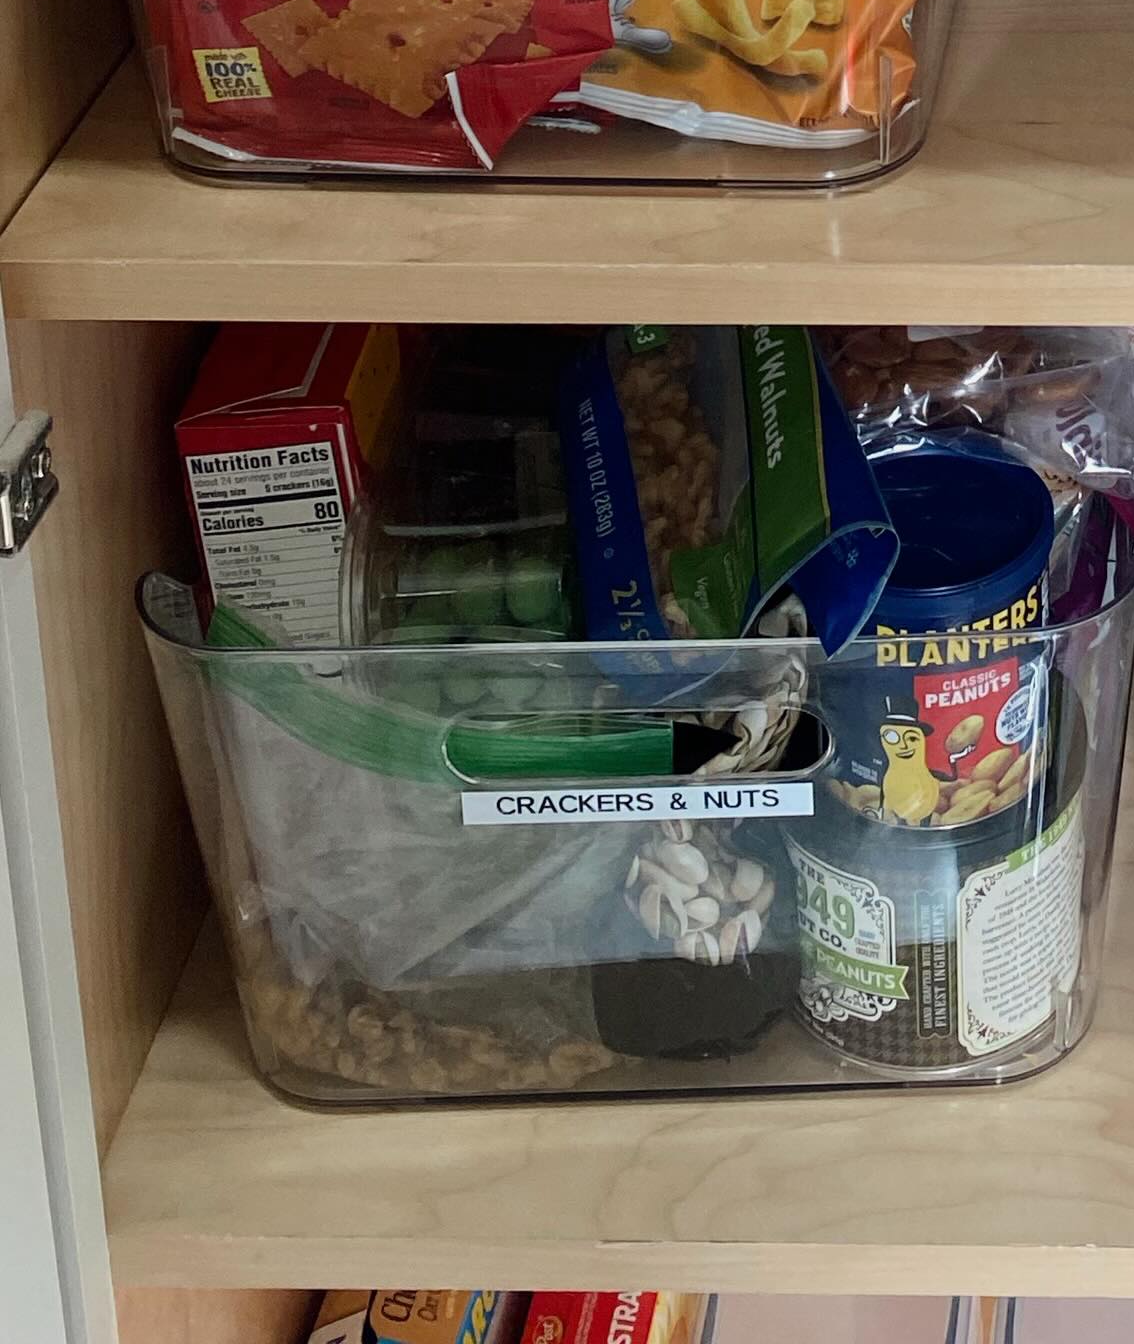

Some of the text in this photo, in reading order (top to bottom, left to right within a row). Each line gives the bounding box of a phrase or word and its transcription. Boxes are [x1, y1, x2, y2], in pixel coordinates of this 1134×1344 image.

[204, 62, 257, 78] 100%
[210, 77, 256, 90] REAL
[215, 87, 262, 99] CHEESE
[759, 352, 786, 470] Walnuts
[190, 446, 329, 474] Nutrition Facts
[587, 451, 604, 472] 10
[196, 489, 228, 500] Serving
[273, 481, 310, 492] crackers
[312, 478, 334, 490] (16g)
[202, 501, 340, 532] Calories 80
[876, 584, 1038, 668] PLANTERS
[925, 671, 1011, 709] PEANUTS
[942, 669, 998, 692] CLASSIC
[496, 789, 780, 816] CRACKERS & NUTS
[819, 927, 847, 952] CO.
[816, 947, 897, 990] PEANUTS
[931, 902, 947, 1028] FINEST INGREDIENTS
